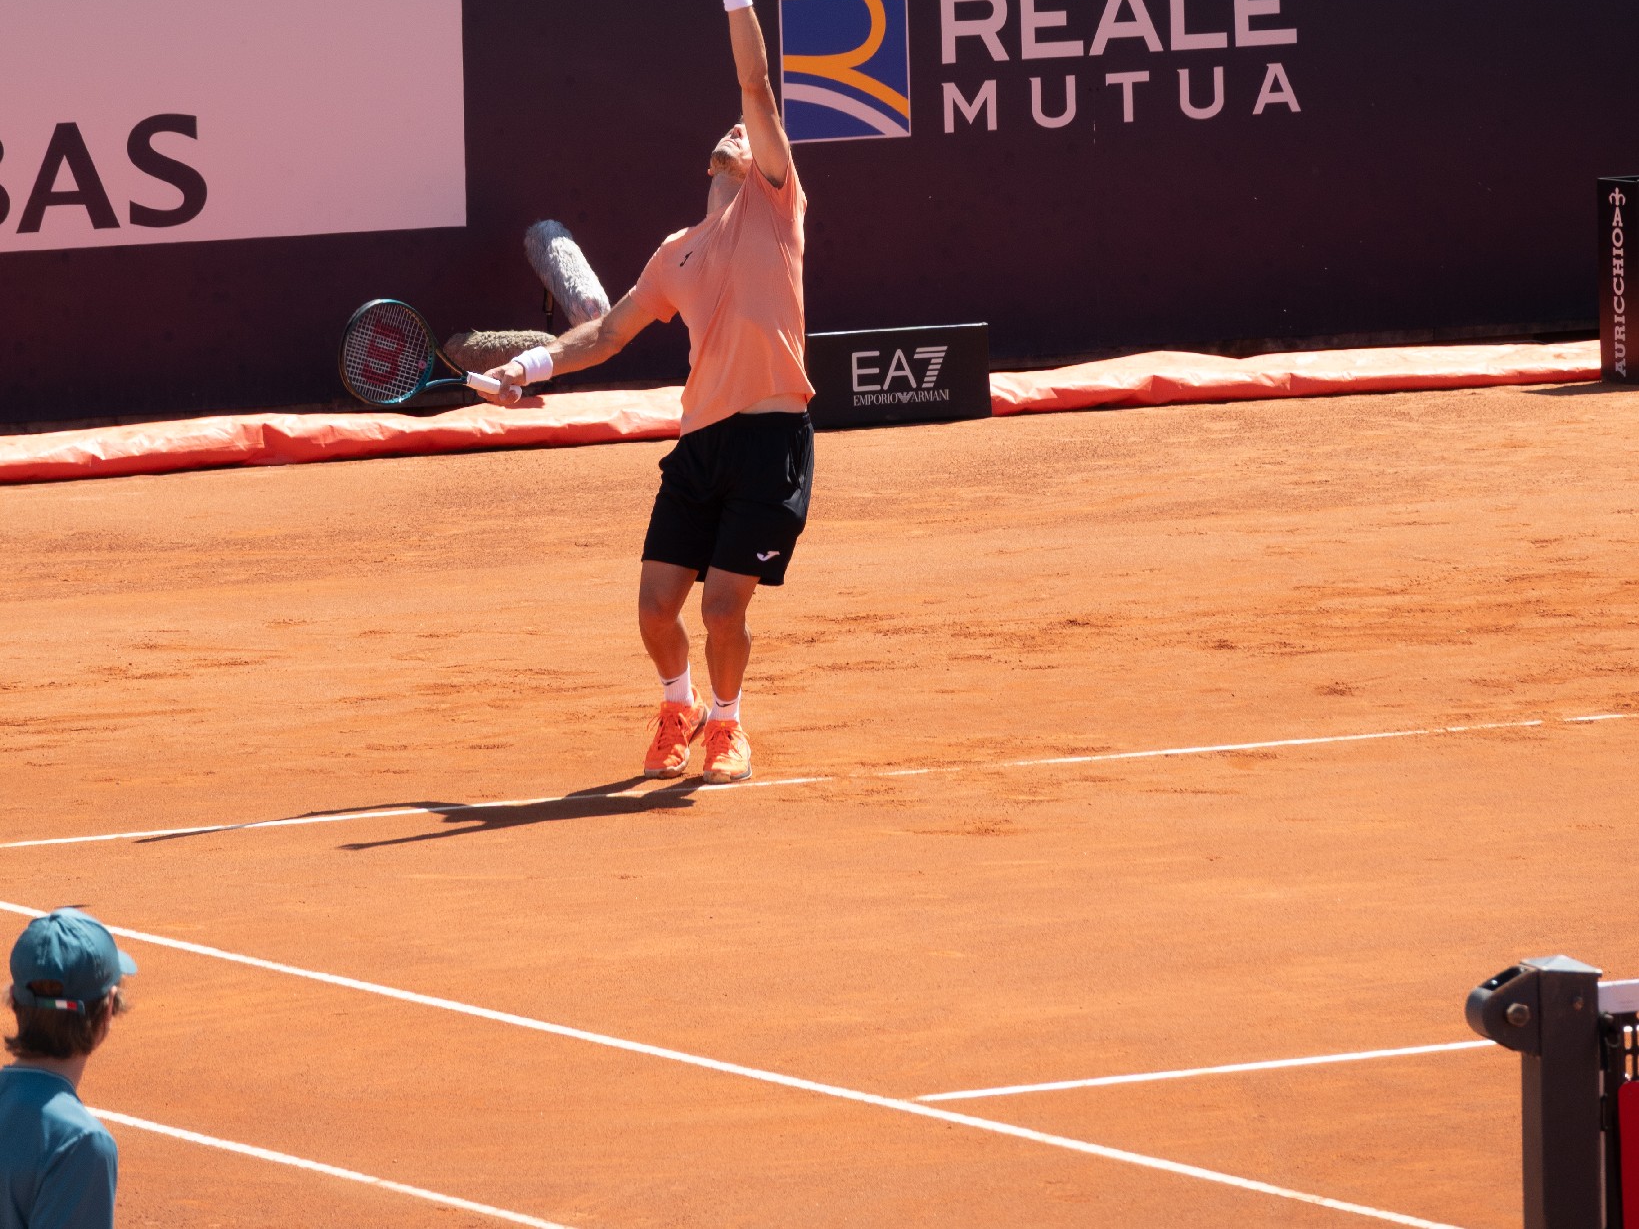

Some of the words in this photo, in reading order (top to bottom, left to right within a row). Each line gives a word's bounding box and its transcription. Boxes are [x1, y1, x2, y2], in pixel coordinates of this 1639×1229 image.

[942, 62, 1302, 134] MUTUA
[0, 113, 208, 234] AS
[851, 345, 949, 393] EA7
[853, 392, 898, 407] EMPORIO
[910, 388, 950, 403] ARMANI
